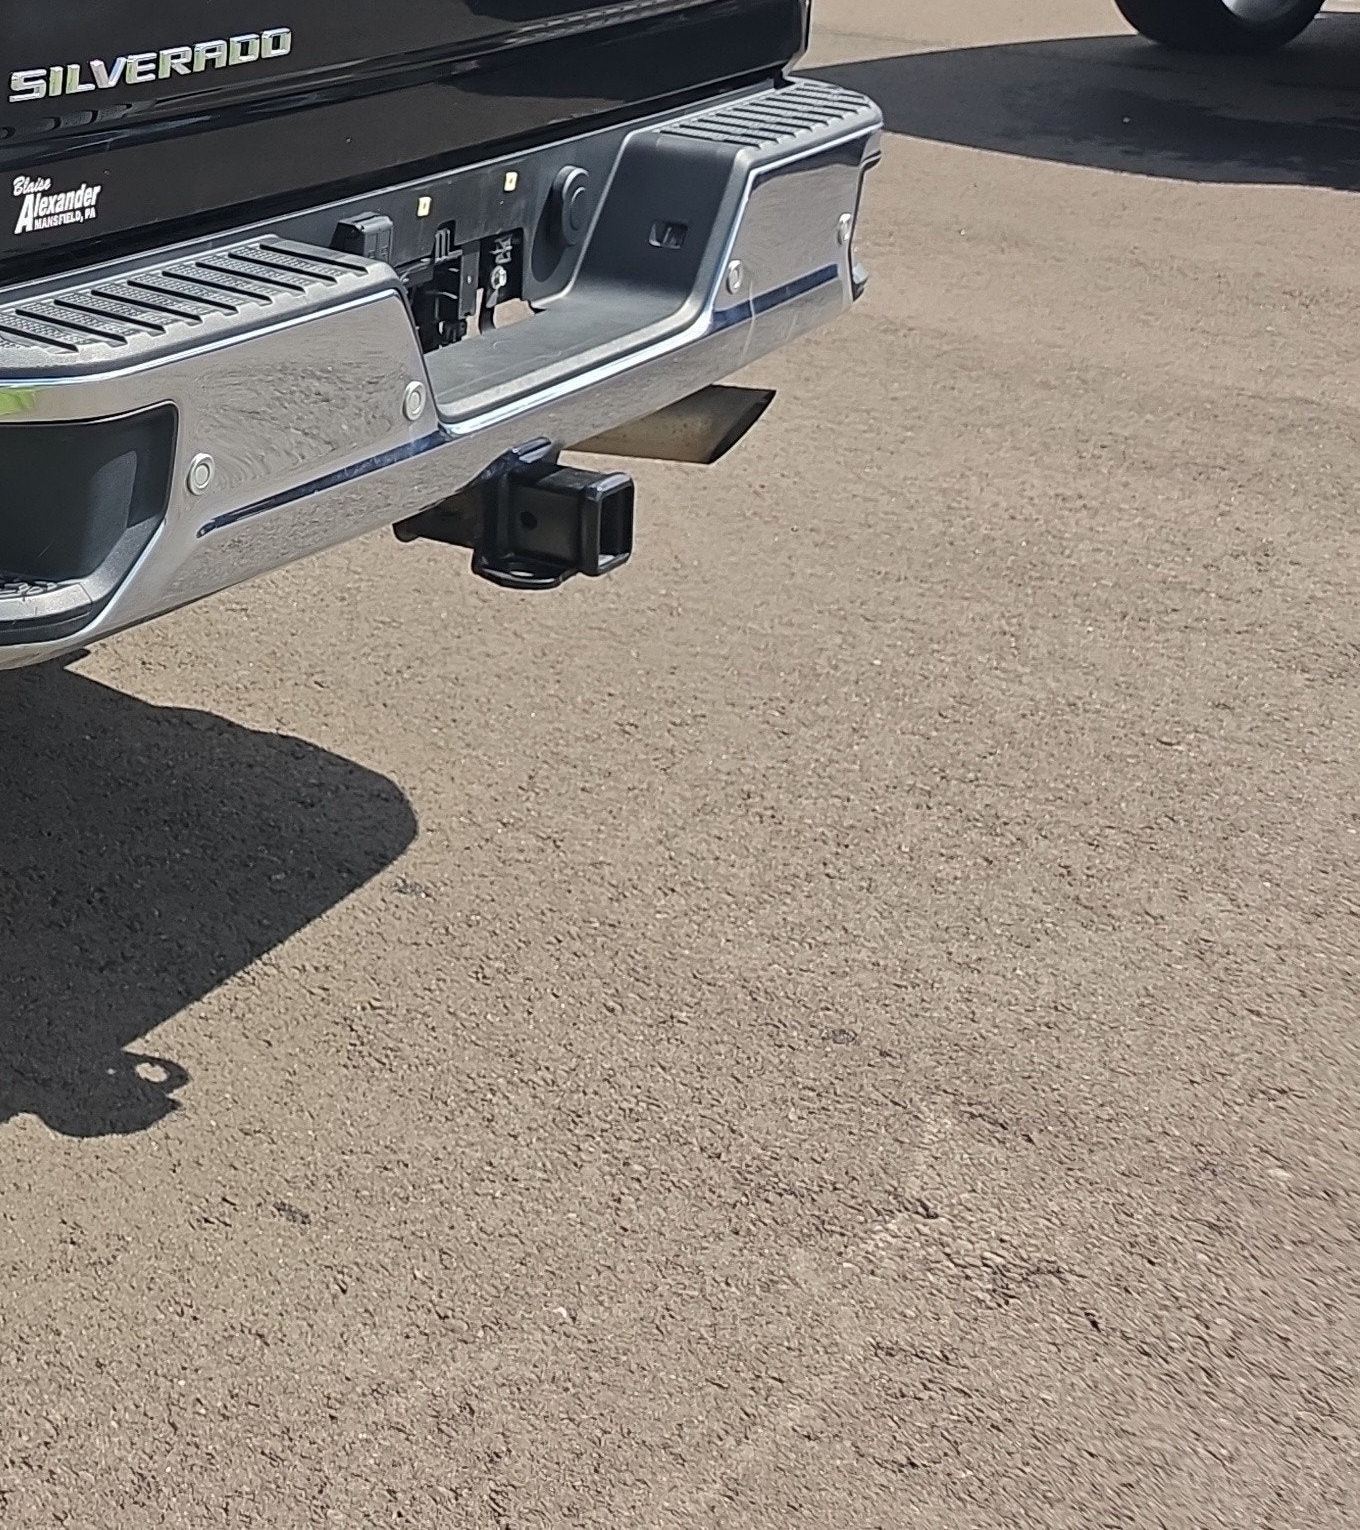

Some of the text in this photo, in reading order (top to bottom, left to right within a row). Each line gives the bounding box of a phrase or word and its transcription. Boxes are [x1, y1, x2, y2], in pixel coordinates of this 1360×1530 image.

[9, 27, 292, 103] SILVERADO
[13, 175, 51, 197] Blaise
[14, 183, 101, 235] Alexander
[34, 207, 96, 231] MANSFIELD, PA
